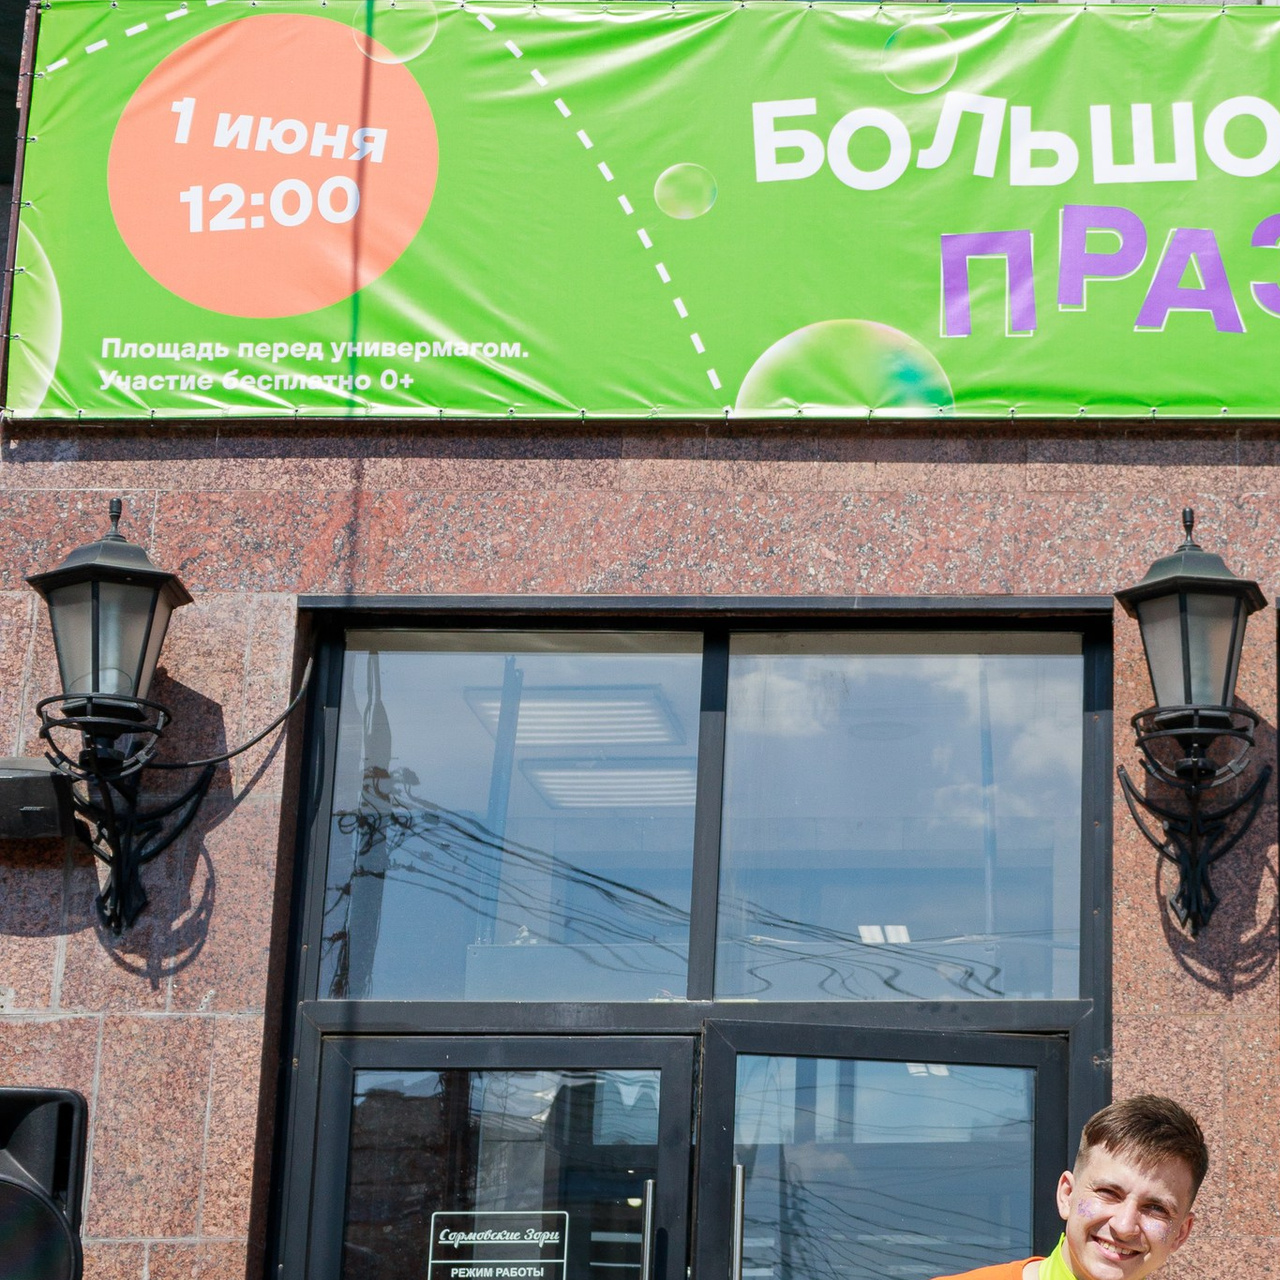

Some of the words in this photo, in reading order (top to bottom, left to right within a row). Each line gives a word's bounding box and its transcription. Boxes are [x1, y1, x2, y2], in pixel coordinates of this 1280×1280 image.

[171, 96, 196, 144] 1
[213, 112, 388, 163] июня
[180, 175, 361, 233] 12:00
[102, 337, 229, 361] Площадь
[238, 340, 323, 363] перед
[331, 341, 529, 363] универмагом.
[99, 370, 213, 392] Участие
[222, 369, 371, 391] бесплатно
[380, 374, 414, 390] 0+
[438, 1228, 520, 1248] Сормовские
[524, 1228, 560, 1247] Зори
[451, 1267, 493, 1277] РЕЖИМ
[496, 1267, 544, 1277] РАБОТЫ
